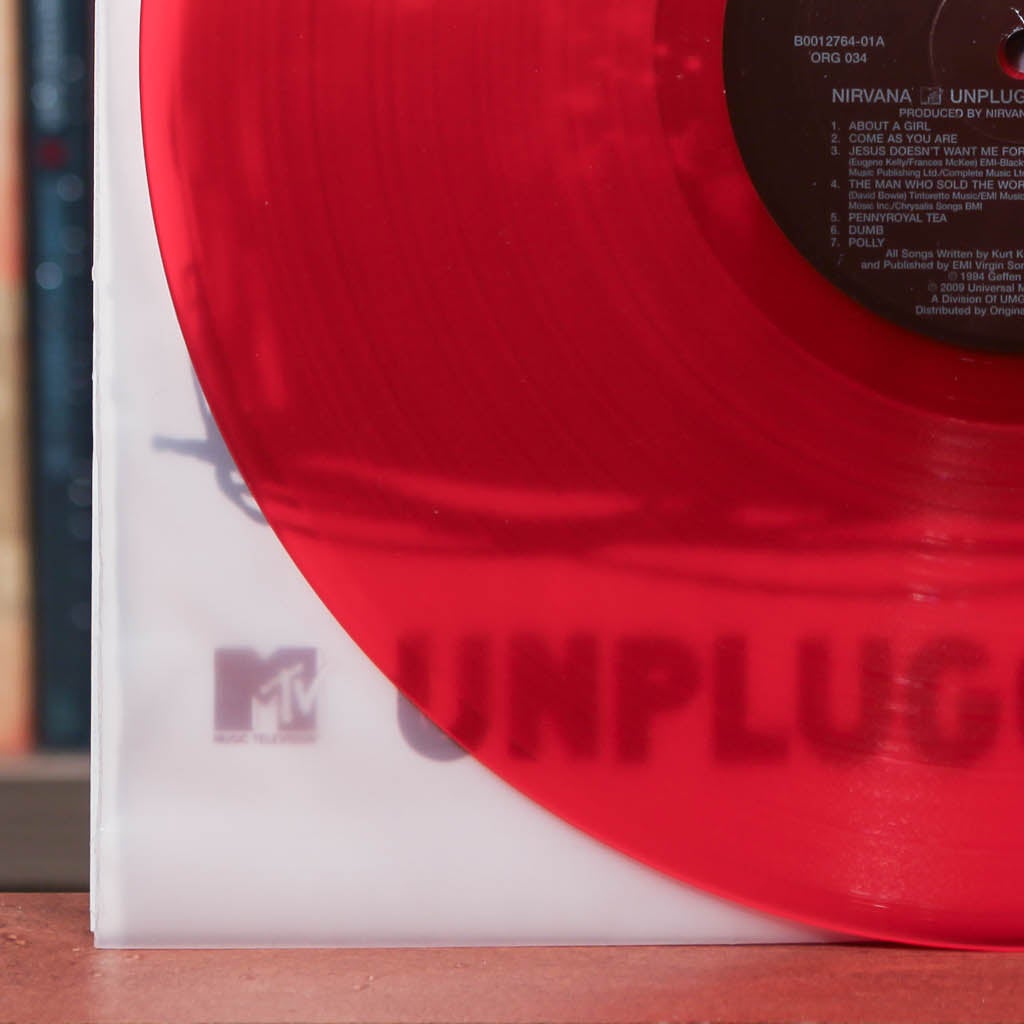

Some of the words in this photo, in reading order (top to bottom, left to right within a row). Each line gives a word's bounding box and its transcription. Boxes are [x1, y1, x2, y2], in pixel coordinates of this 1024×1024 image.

[793, 35, 885, 47] B0012764-01A
[811, 51, 841, 64] ORG
[844, 51, 867, 64] 034
[832, 88, 912, 103] NIRVANA
[899, 107, 963, 118] PRODUCED
[967, 108, 982, 119] BY
[832, 121, 840, 131] 1.
[849, 121, 889, 131] ABOUT
[892, 121, 900, 131] A
[904, 121, 931, 131] GIRL
[831, 133, 840, 144] 2.
[849, 133, 884, 144] COME
[887, 133, 903, 144] AS
[906, 133, 931, 144] YOU
[934, 133, 958, 144] ARE
[831, 146, 840, 156] 3.
[849, 146, 886, 156] JESUS
[889, 146, 940, 156] DOESN'T
[943, 146, 977, 156] WANT
[981, 146, 998, 156] ME
[830, 179, 840, 189] 4.
[849, 179, 871, 189] THE
[875, 179, 901, 189] MAN
[905, 179, 933, 189] WHO
[936, 179, 968, 189] SOLD
[972, 179, 994, 189] THE
[830, 213, 840, 223] 5.
[849, 213, 923, 223] PENNYROYAL
[926, 213, 947, 223] TEA
[830, 225, 840, 235] 6.
[849, 225, 884, 235] DUMB
[831, 238, 840, 247] 7.
[849, 237, 885, 248] POLLY
[886, 249, 898, 258] All
[902, 249, 933, 259] Songs
[936, 249, 972, 258] Written
[976, 249, 988, 260] by
[991, 250, 1013, 259] Kurt
[861, 261, 880, 270] and
[883, 261, 934, 270] Published
[936, 261, 949, 271] by
[952, 261, 972, 270] EMI
[975, 261, 1004, 271] Virgin
[988, 272, 1021, 281] Geffen
[940, 283, 965, 292] 2009
[968, 283, 1014, 292] Universal
[931, 295, 938, 304] A
[942, 295, 981, 304] Division
[985, 295, 997, 304] Of
[916, 306, 971, 315] Distributed
[974, 306, 987, 317] by
